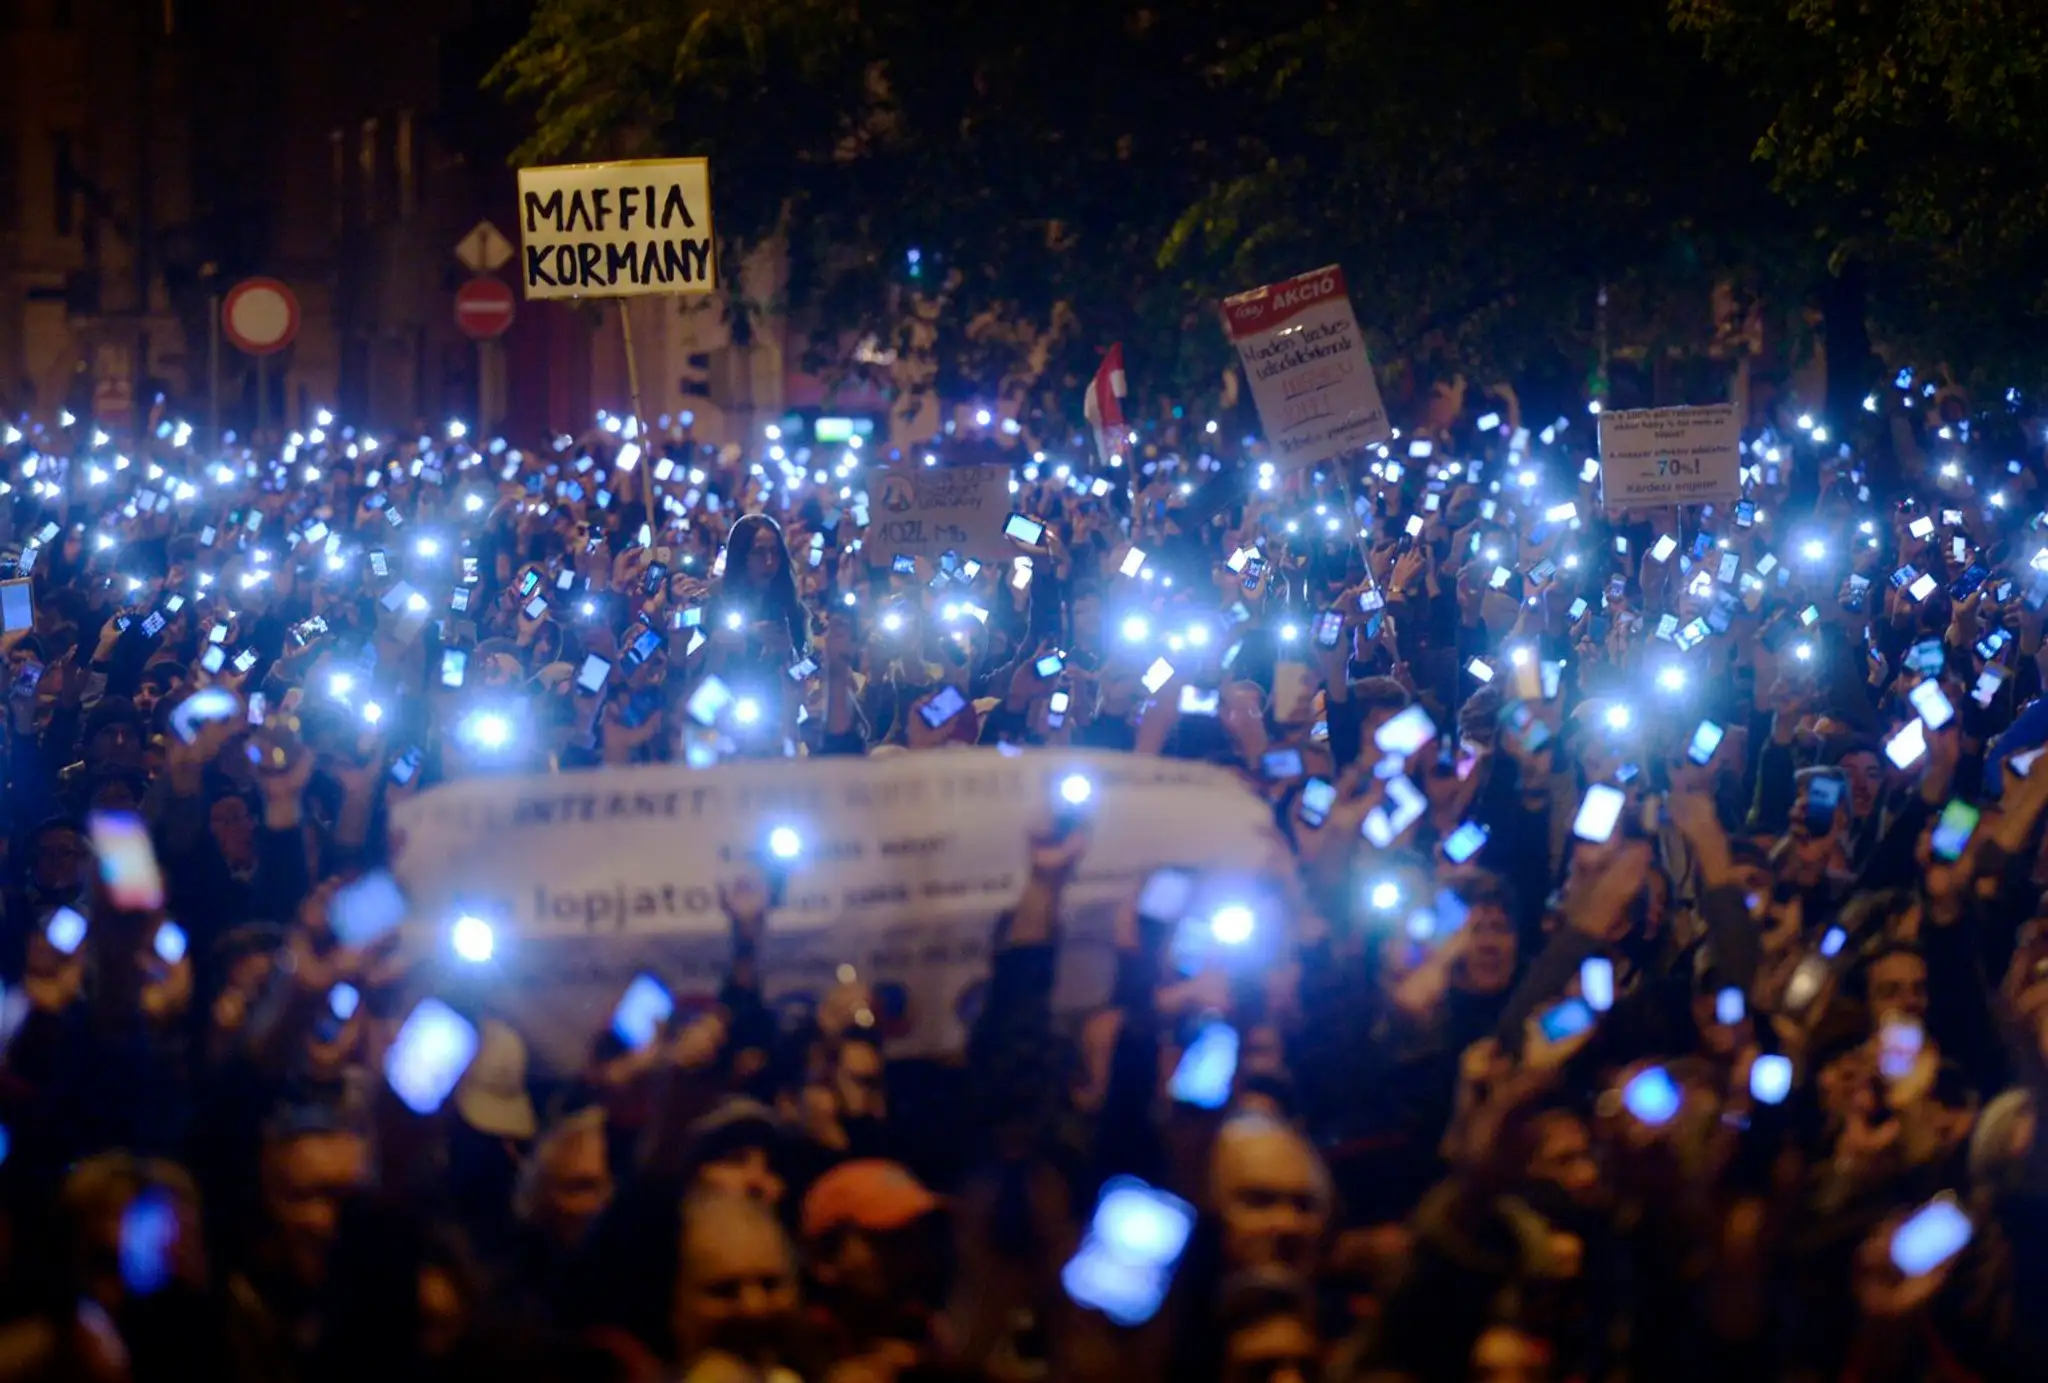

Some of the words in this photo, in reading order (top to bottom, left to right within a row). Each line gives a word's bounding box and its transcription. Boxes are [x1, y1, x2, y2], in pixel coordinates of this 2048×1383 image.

[525, 183, 695, 232] MAFFIA
[526, 238, 710, 287] KORMANY
[1273, 273, 1335, 311] AKCIÓ
